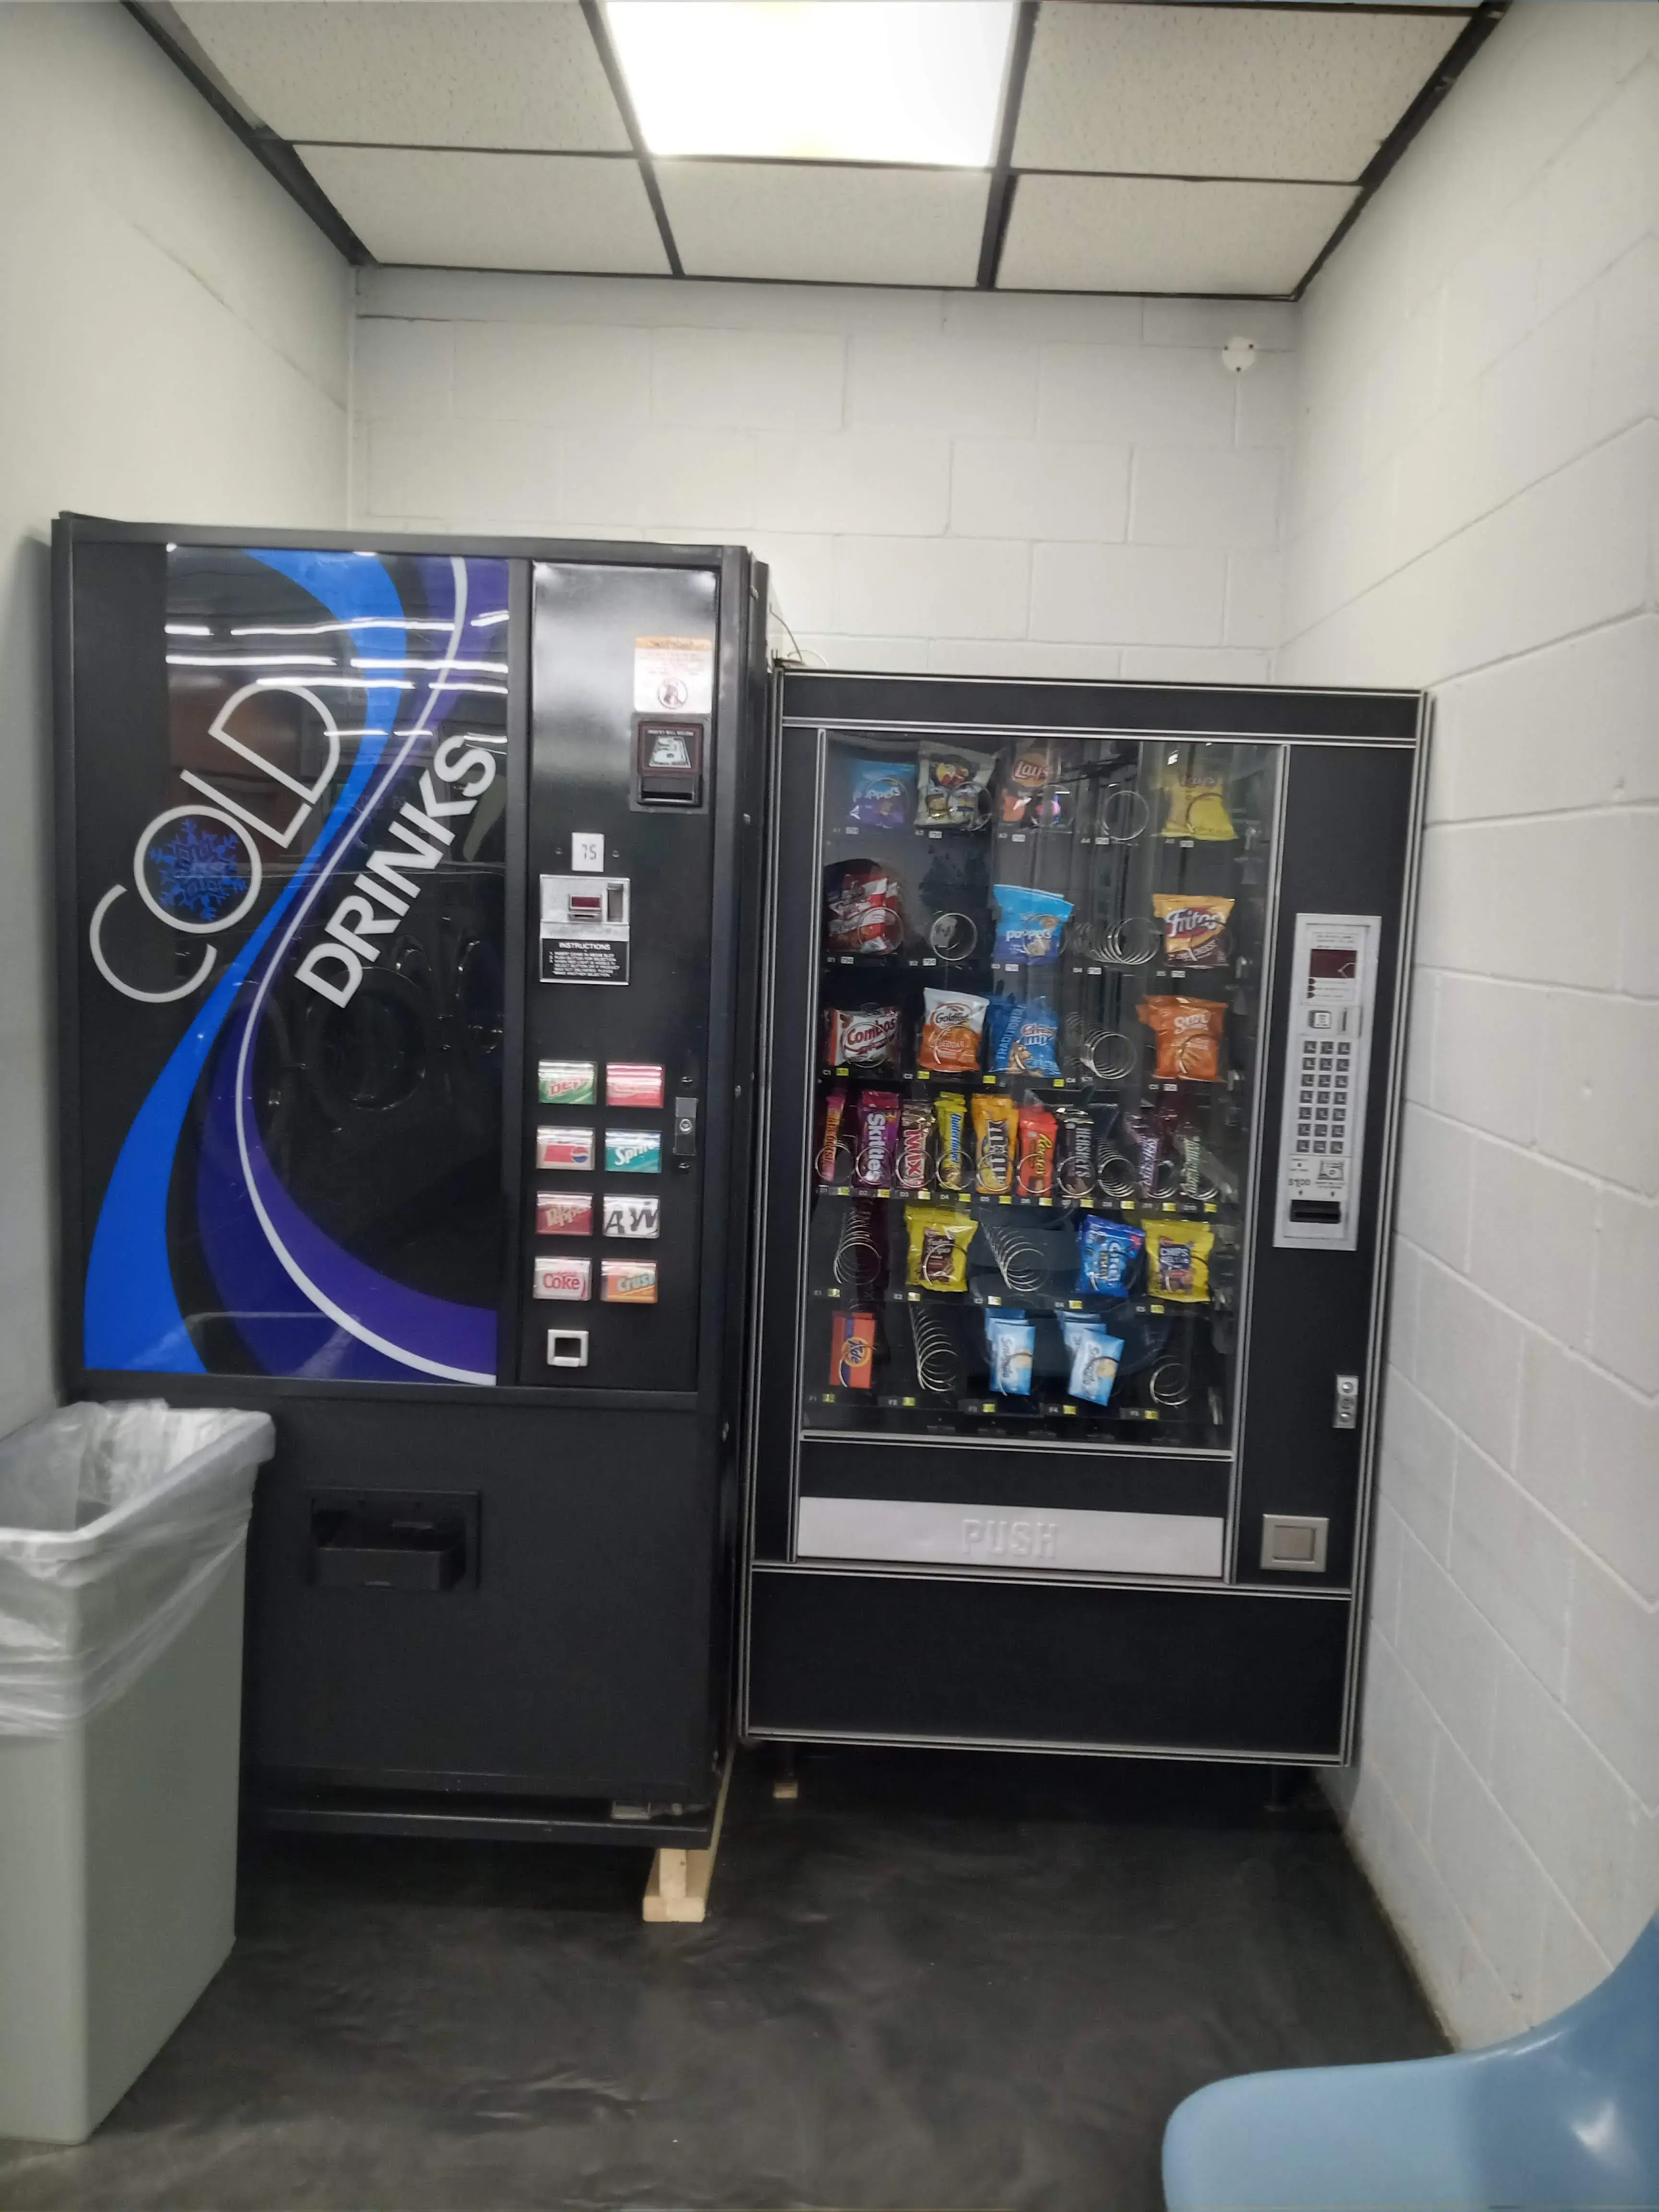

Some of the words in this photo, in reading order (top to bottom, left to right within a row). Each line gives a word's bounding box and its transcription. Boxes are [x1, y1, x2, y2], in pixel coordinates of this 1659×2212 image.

[90, 683, 340, 1003] COLD
[294, 734, 496, 1009] DRINKS
[1164, 908, 1226, 938] Fritos
[559, 941, 611, 951] INSTRUCTIONS
[846, 1017, 898, 1046] Combos
[865, 1113, 887, 1182] Skittles
[543, 1272, 580, 1290] Coke
[962, 1518, 1058, 1558] PUSH
